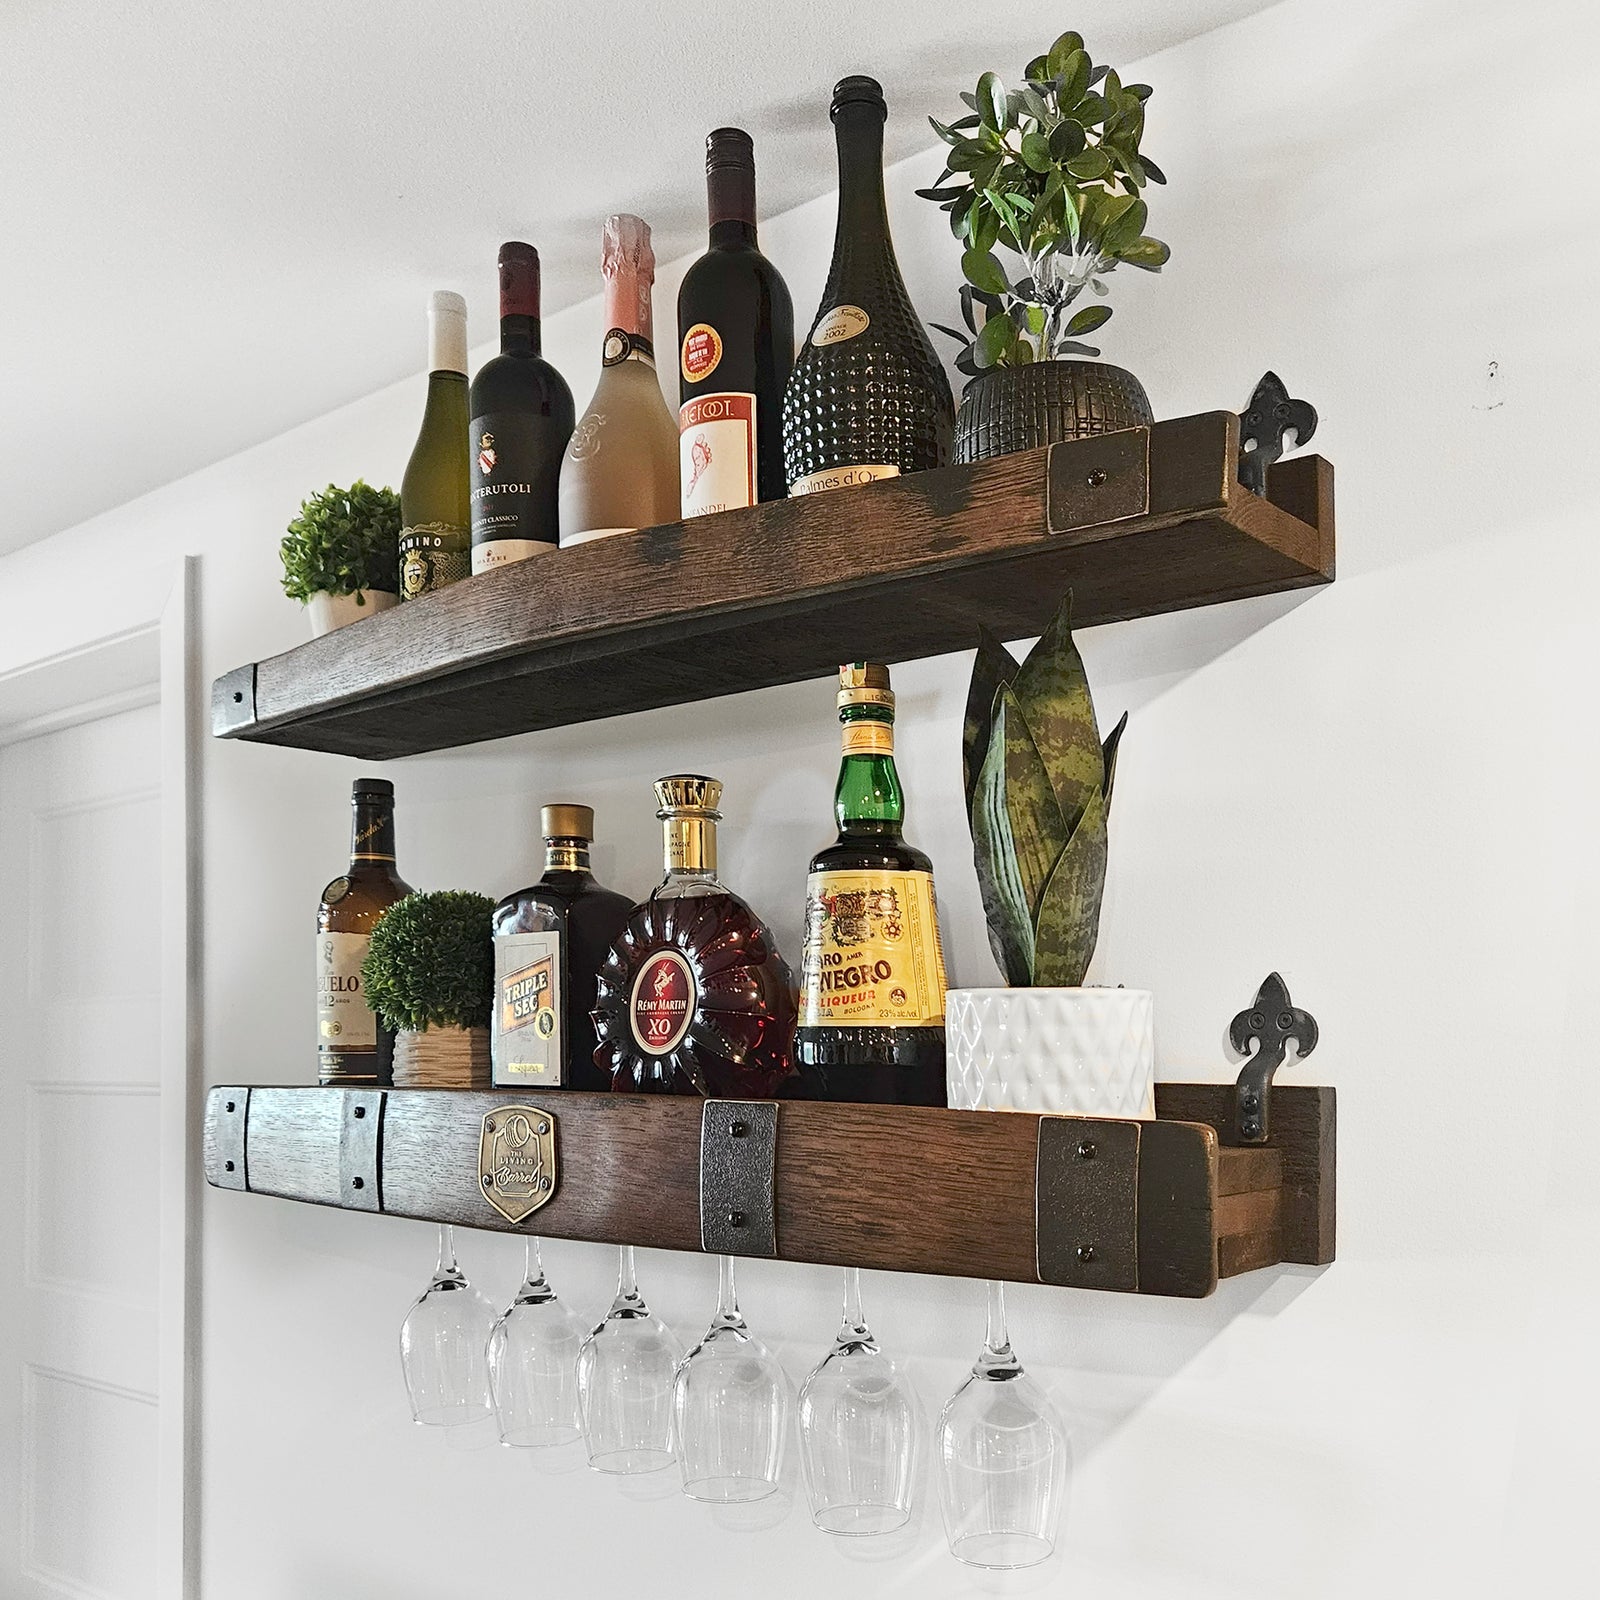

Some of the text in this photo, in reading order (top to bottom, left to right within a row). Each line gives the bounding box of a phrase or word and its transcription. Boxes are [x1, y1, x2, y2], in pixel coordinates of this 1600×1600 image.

[823, 328, 847, 341] 2002
[800, 475, 840, 494] Palmes
[487, 513, 519, 524] CLASSICO
[505, 972, 547, 1003] TRIPLE
[514, 995, 538, 1018] SEC
[637, 999, 687, 1011] RÉMY MARTIN
[820, 989, 876, 1008] LIQUEUR
[647, 1018, 671, 1036] XO
[500, 1156, 534, 1166] LIVING
[490, 1162, 542, 1185] Barrel
